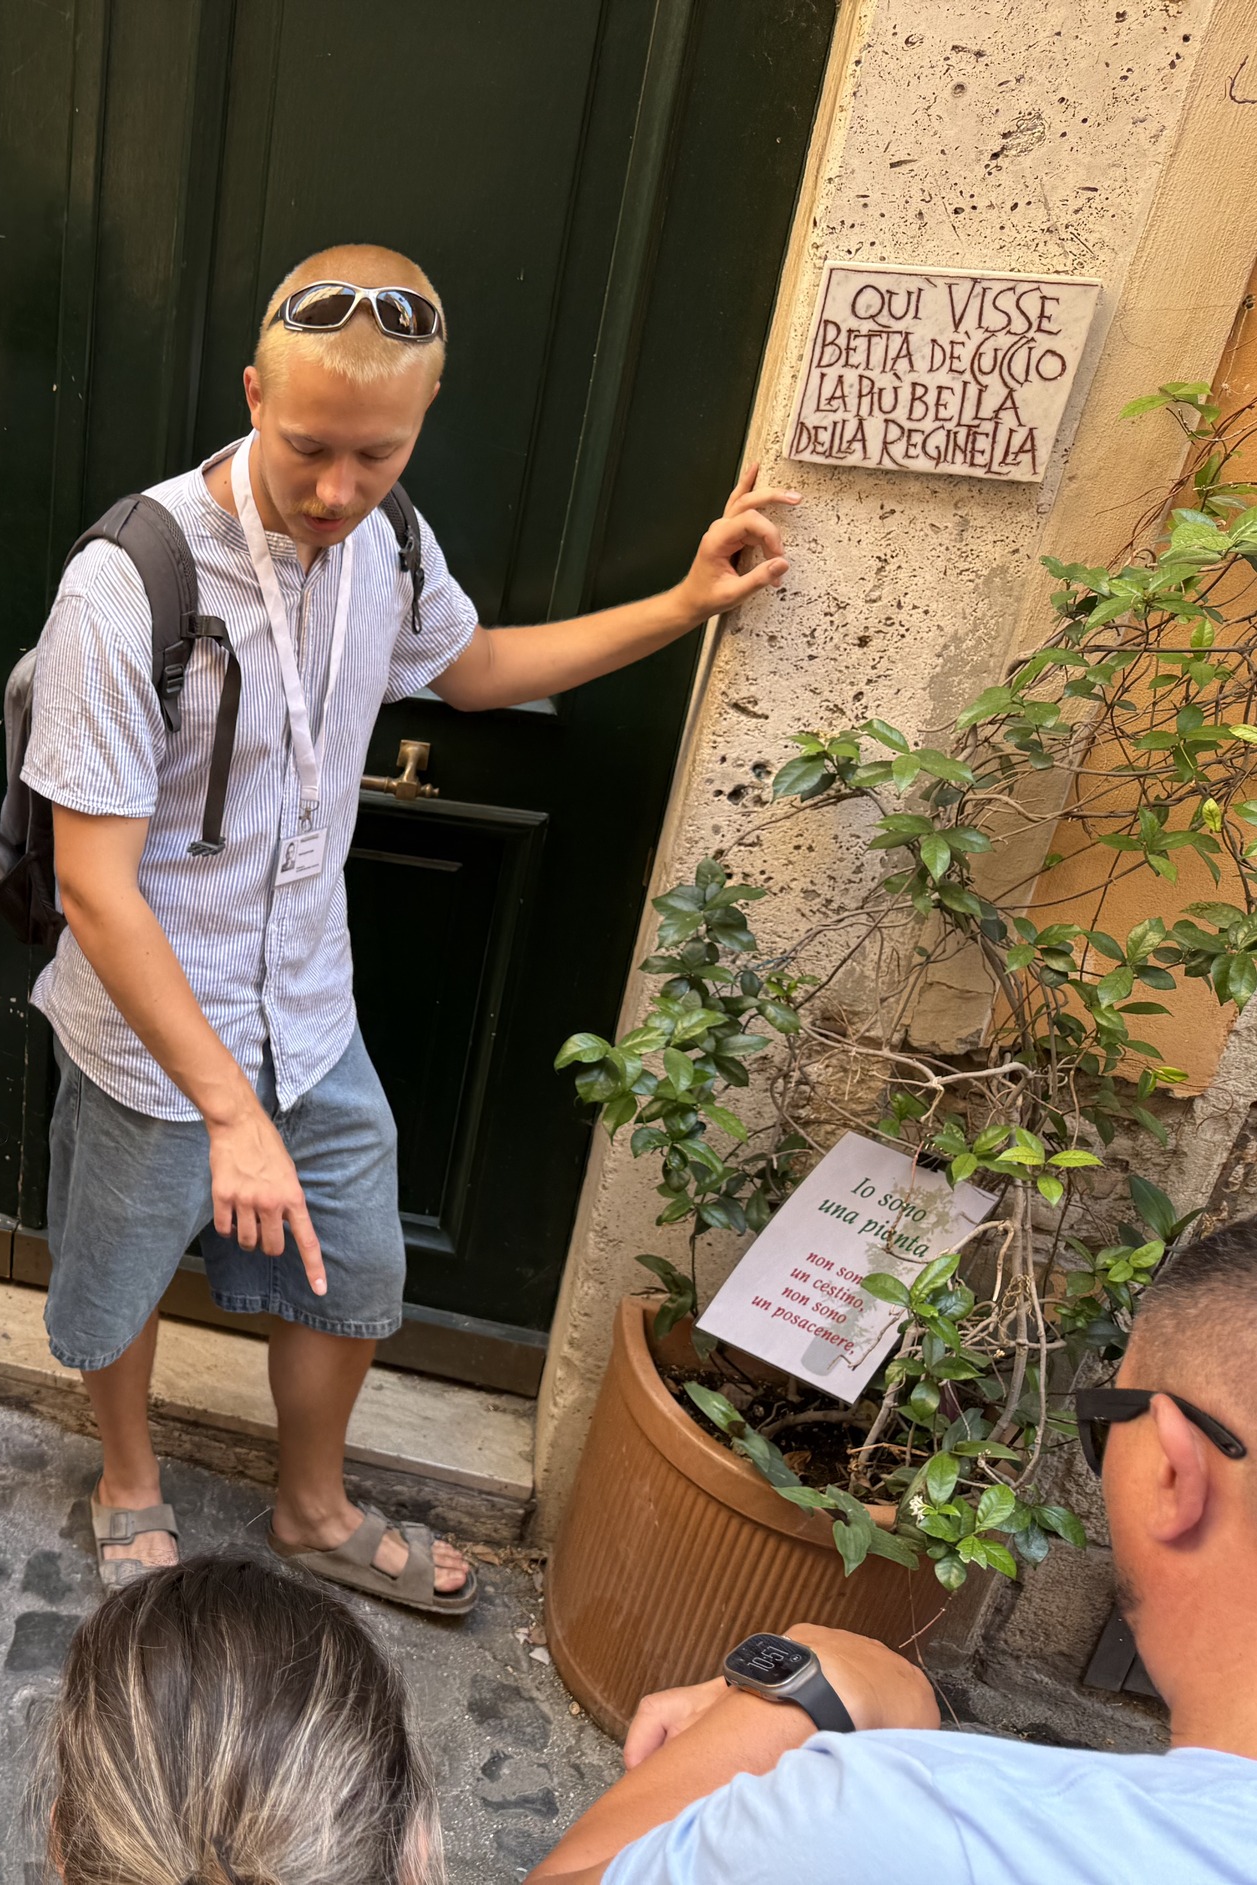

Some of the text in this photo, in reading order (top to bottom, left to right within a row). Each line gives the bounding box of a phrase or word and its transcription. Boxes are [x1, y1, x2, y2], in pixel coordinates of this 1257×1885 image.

[945, 277, 1062, 335] VISSE
[815, 319, 920, 374] BETTA
[970, 334, 1067, 389] CUCCIO
[814, 372, 1026, 427] LA PIÙ BELLA
[794, 418, 1039, 476] DELLA REGINELLA
[818, 1199, 860, 1225] una
[851, 1177, 927, 1222] Io sono
[790, 1268, 864, 1312] un cestino,
[806, 1252, 863, 1284] non son
[751, 1295, 855, 1355] un posacenere,
[781, 1287, 847, 1324] non sono
